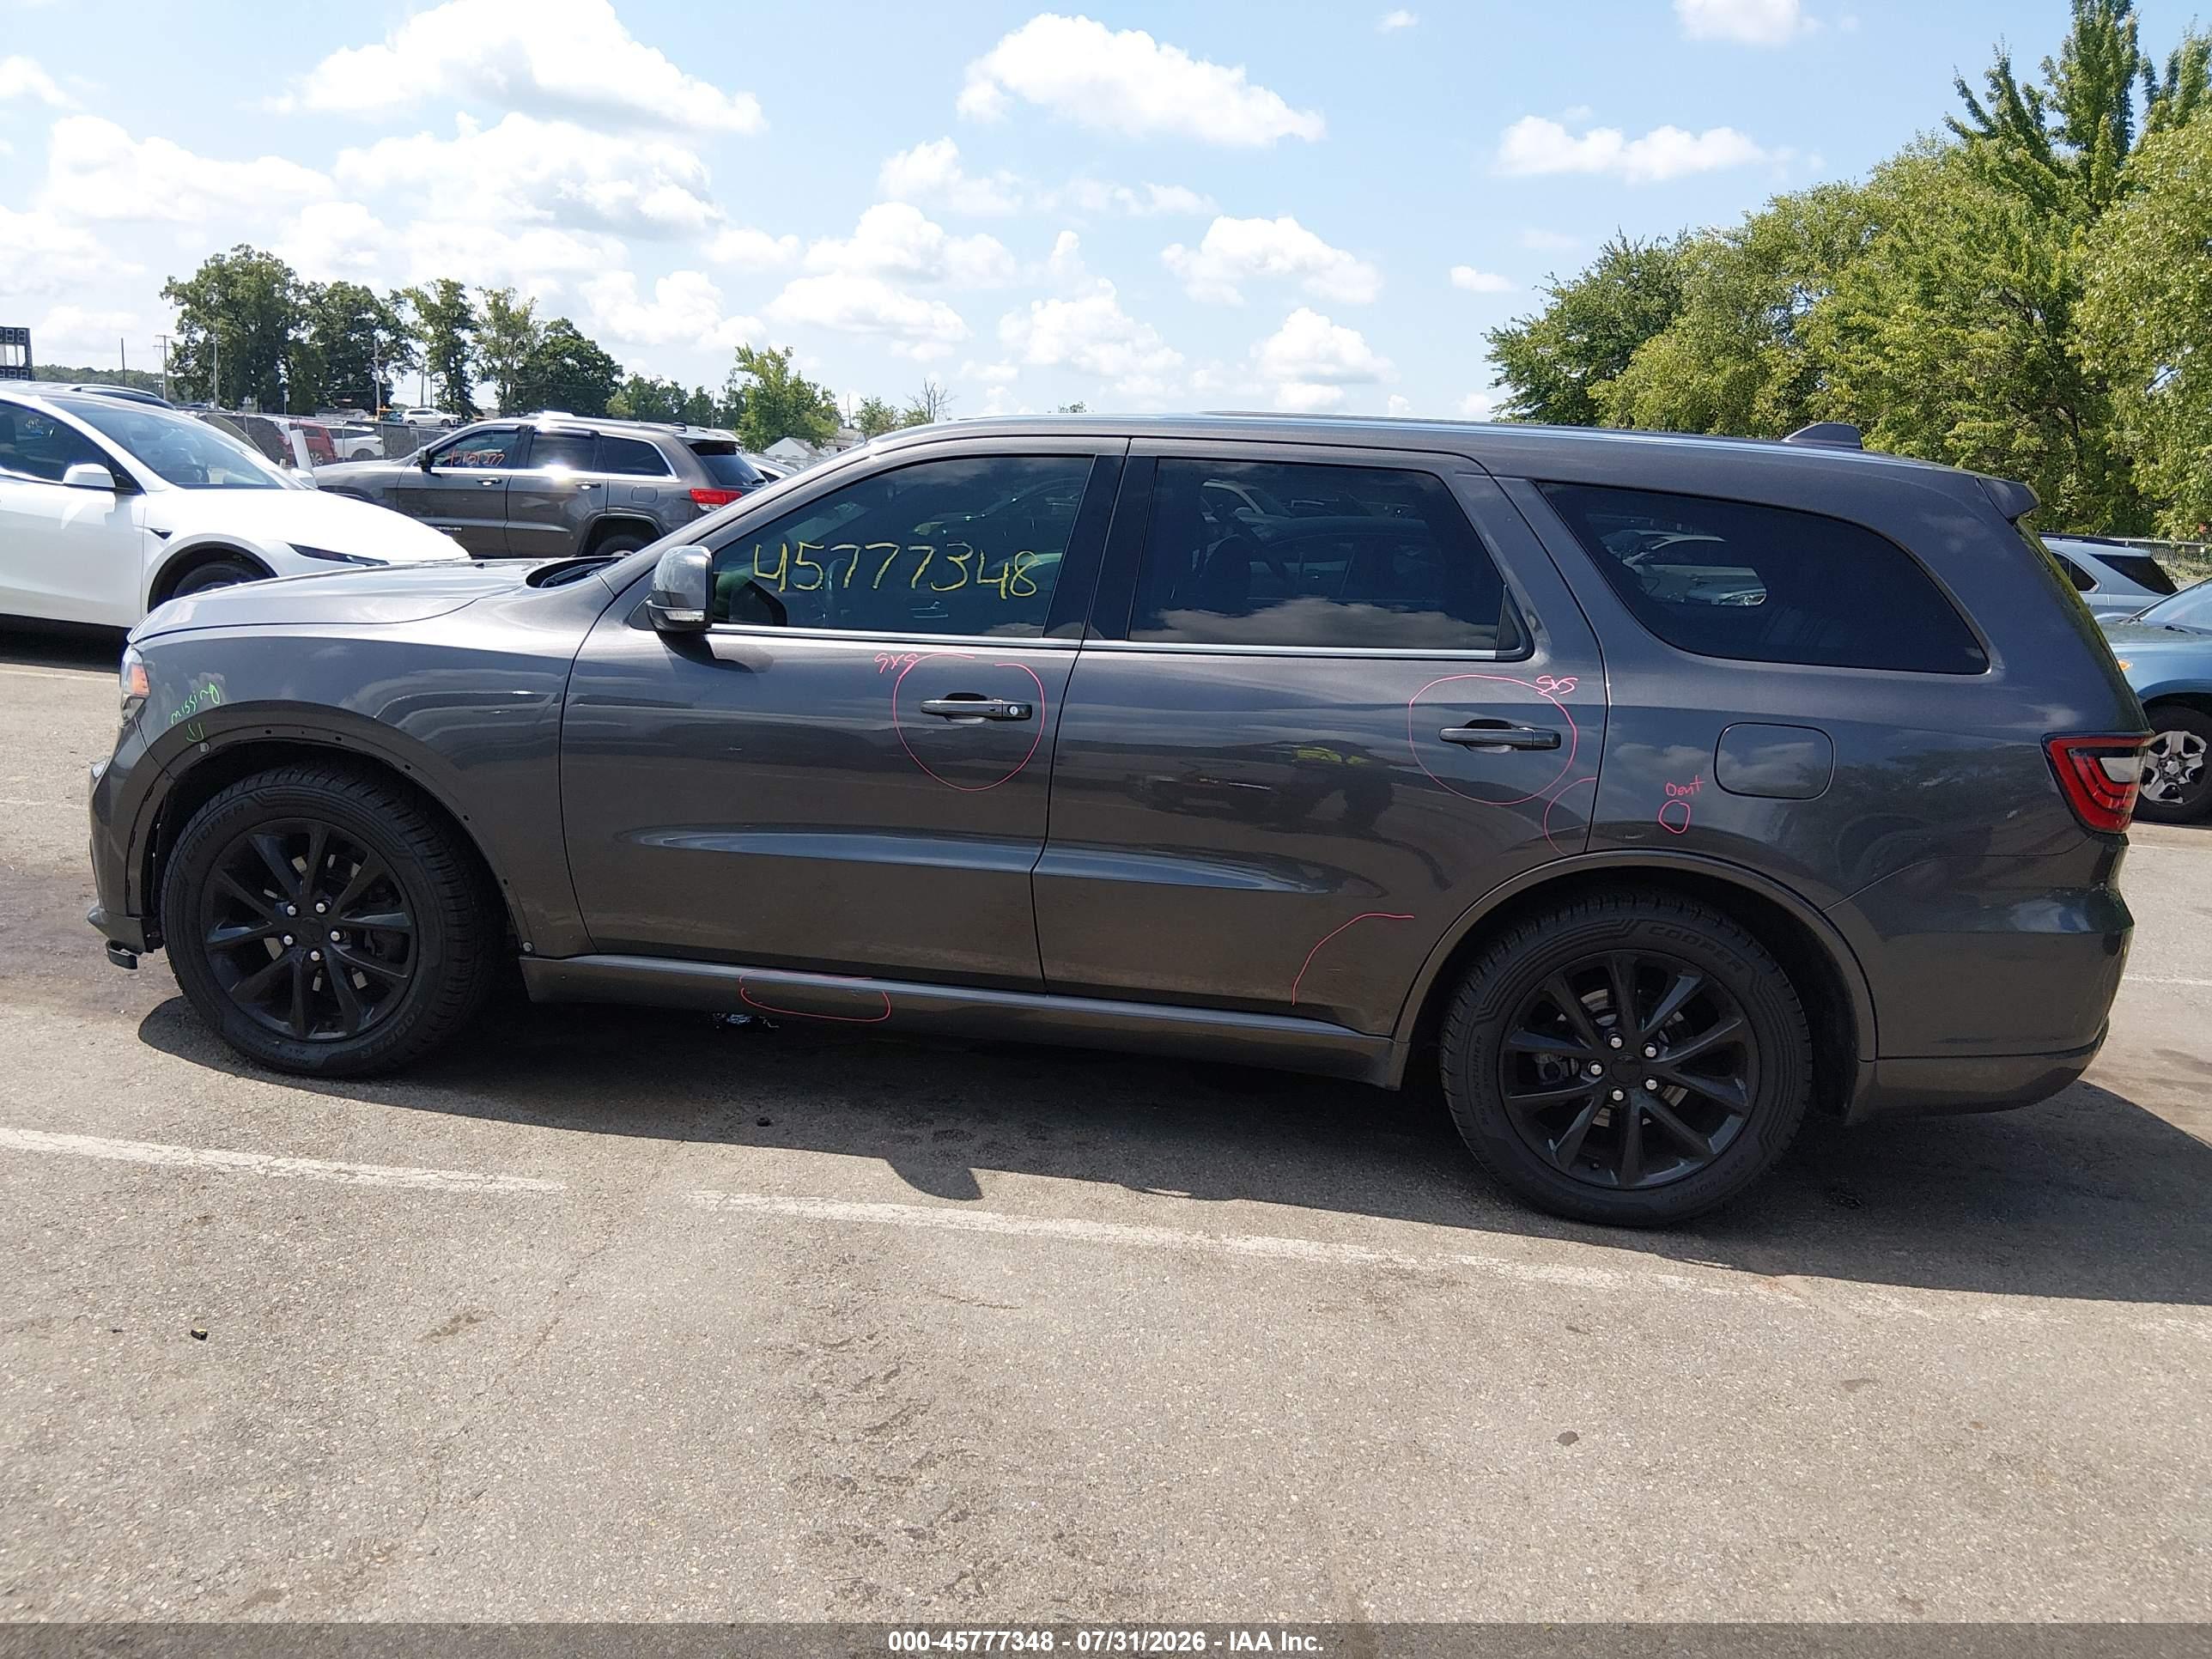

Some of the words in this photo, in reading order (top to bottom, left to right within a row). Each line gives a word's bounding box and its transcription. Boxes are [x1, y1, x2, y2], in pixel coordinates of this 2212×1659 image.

[753, 541, 1038, 600] 45777348
[170, 682, 220, 726] missing
[1665, 775, 1705, 796] Dent
[1649, 926, 1744, 972] COOPER
